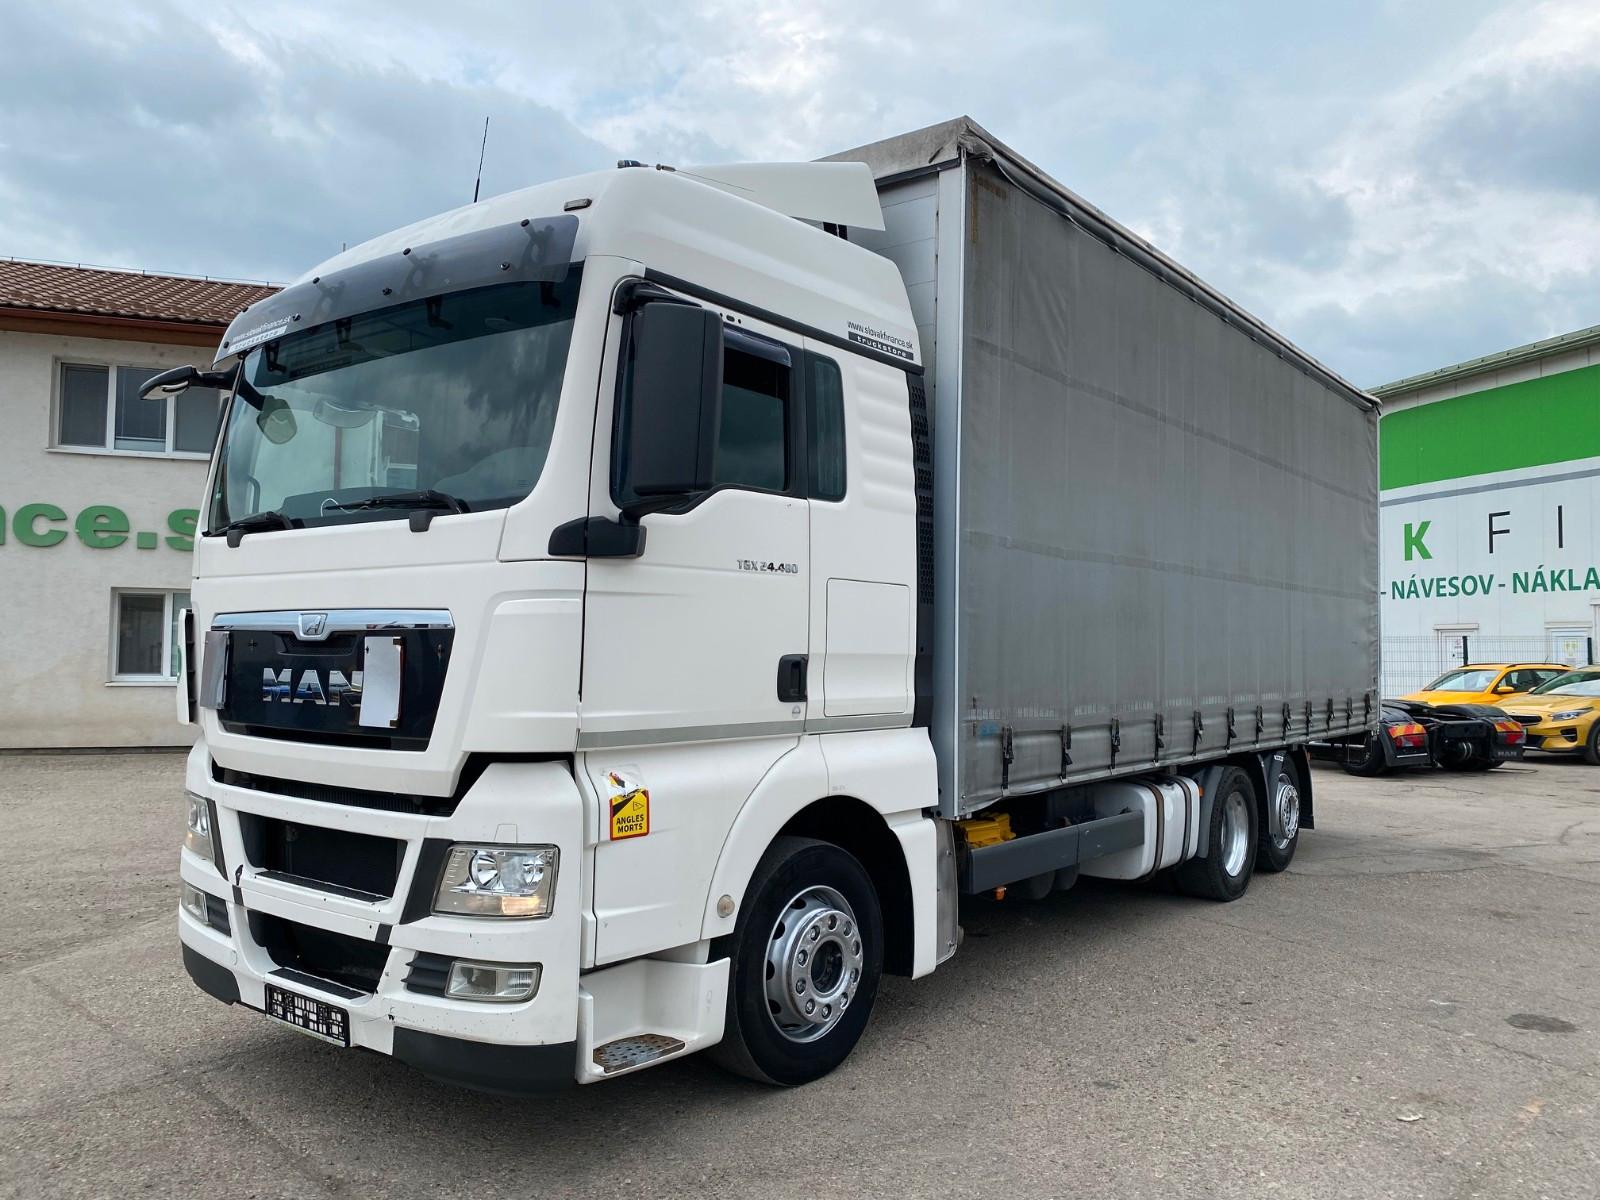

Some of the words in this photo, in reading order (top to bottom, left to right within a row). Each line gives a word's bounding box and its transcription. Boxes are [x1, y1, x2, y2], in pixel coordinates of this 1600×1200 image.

[857, 335, 907, 358] truckstore
[1391, 573, 1495, 600] NÁVESOV
[262, 667, 365, 706] MAN
[616, 814, 644, 825] ANGLES
[617, 823, 643, 833] MORTS
